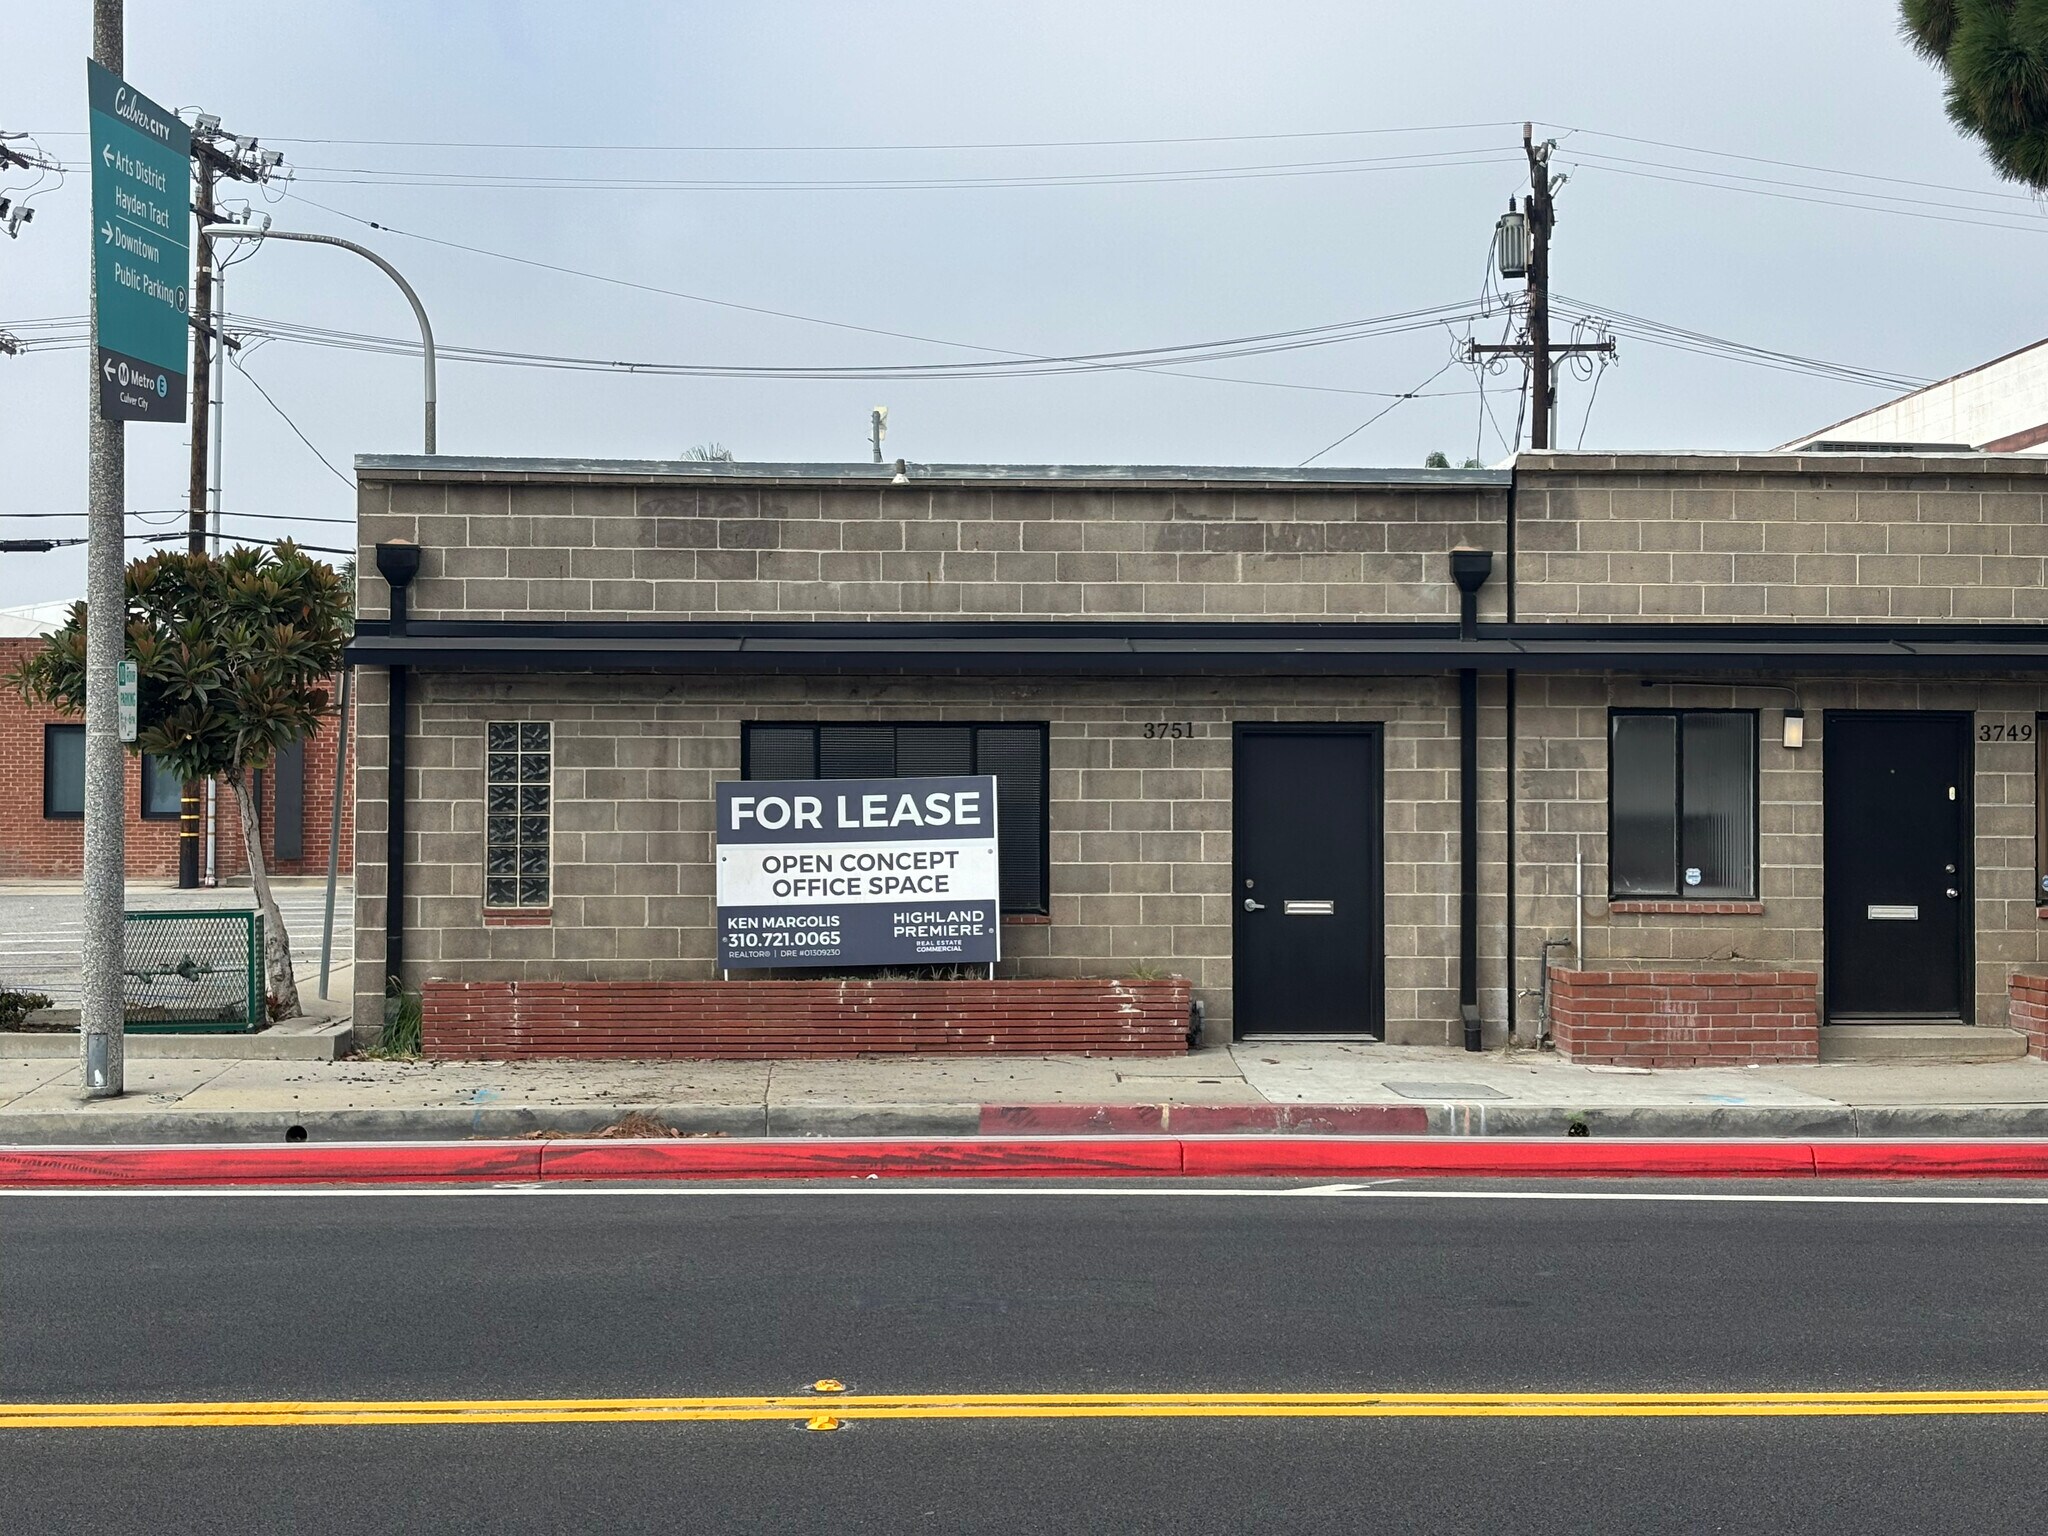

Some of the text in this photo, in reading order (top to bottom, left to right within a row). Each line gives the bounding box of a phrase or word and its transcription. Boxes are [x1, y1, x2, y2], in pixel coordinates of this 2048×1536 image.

[115, 87, 170, 140] Culver CITY
[115, 151, 166, 193] Arts District
[115, 186, 170, 229] Hayden Tract
[115, 227, 160, 264] Downtown
[115, 263, 141, 291] Public
[143, 277, 174, 308] Parking
[131, 369, 155, 390] Metro
[120, 391, 148, 412] Culver City
[1143, 722, 1194, 739] 3751
[1979, 724, 2032, 741] 3749
[730, 791, 981, 830] FOR LEASE
[762, 851, 959, 874] OPEN CONCEPT
[772, 875, 950, 897] OFFICE SPACE
[727, 915, 840, 929] KEN MARGOLIS
[893, 910, 985, 924] HIGHLAND
[728, 931, 841, 947] 310.721.0065
[893, 924, 984, 938] PREMIERE
[780, 949, 798, 957] DRE
